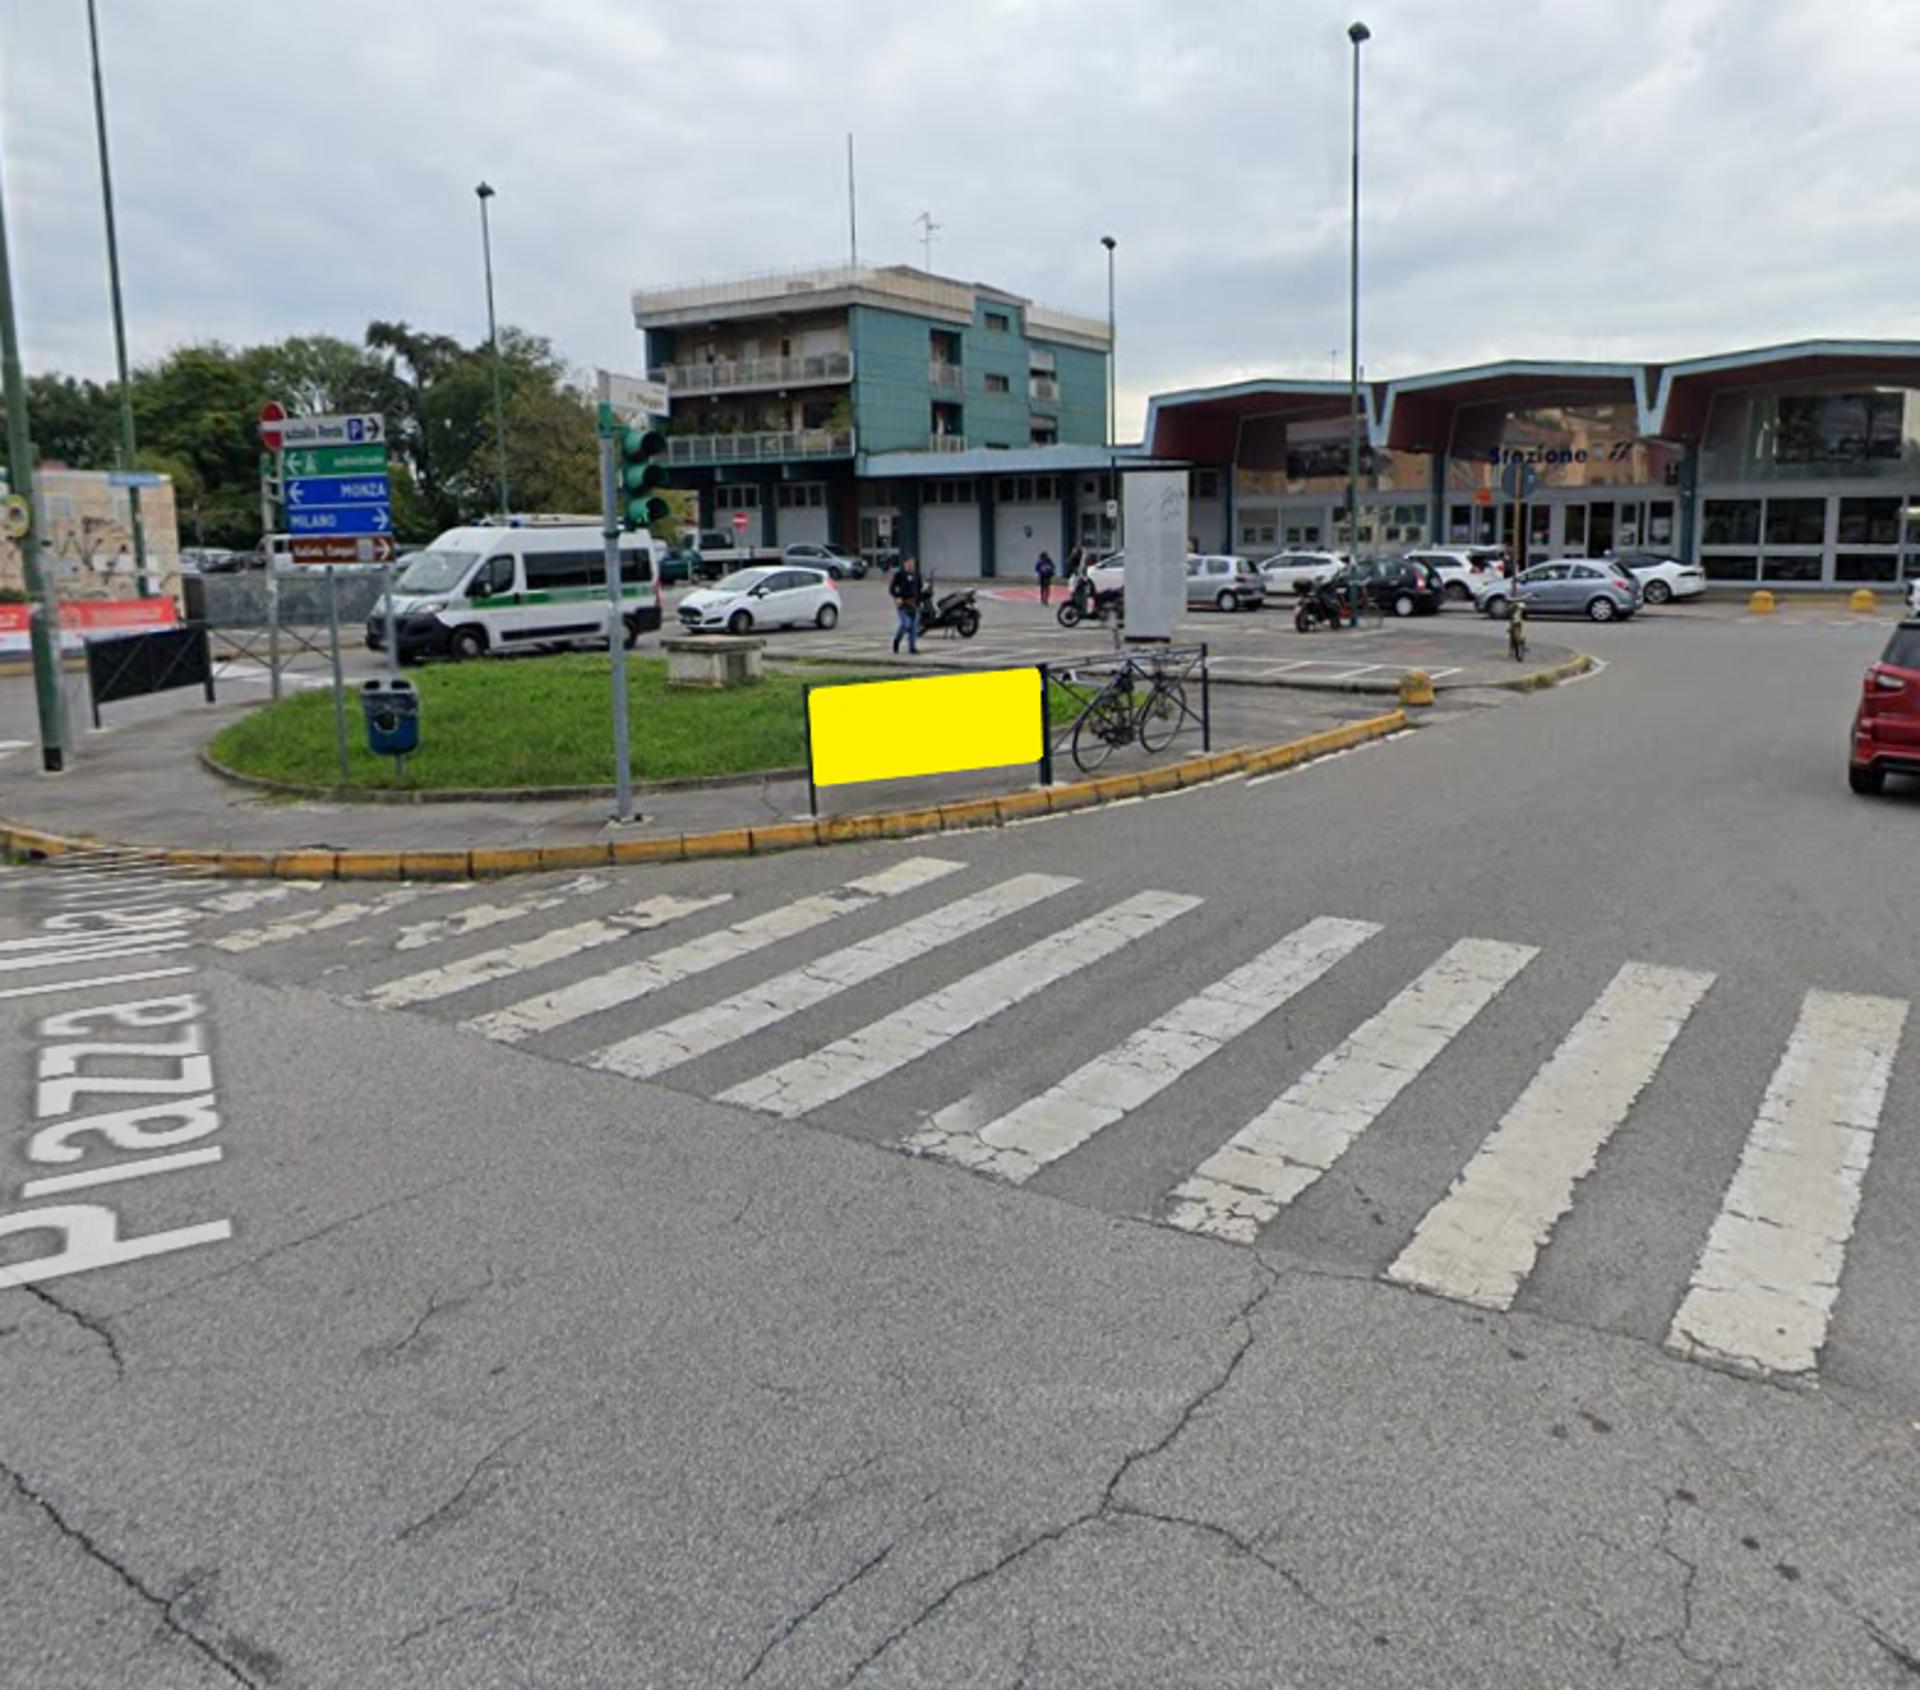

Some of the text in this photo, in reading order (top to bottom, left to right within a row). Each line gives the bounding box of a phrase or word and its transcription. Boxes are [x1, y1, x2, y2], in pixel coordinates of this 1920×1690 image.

[1489, 443, 1588, 465] Stazione
[340, 482, 387, 499] MONZA
[290, 513, 337, 529] MILANO
